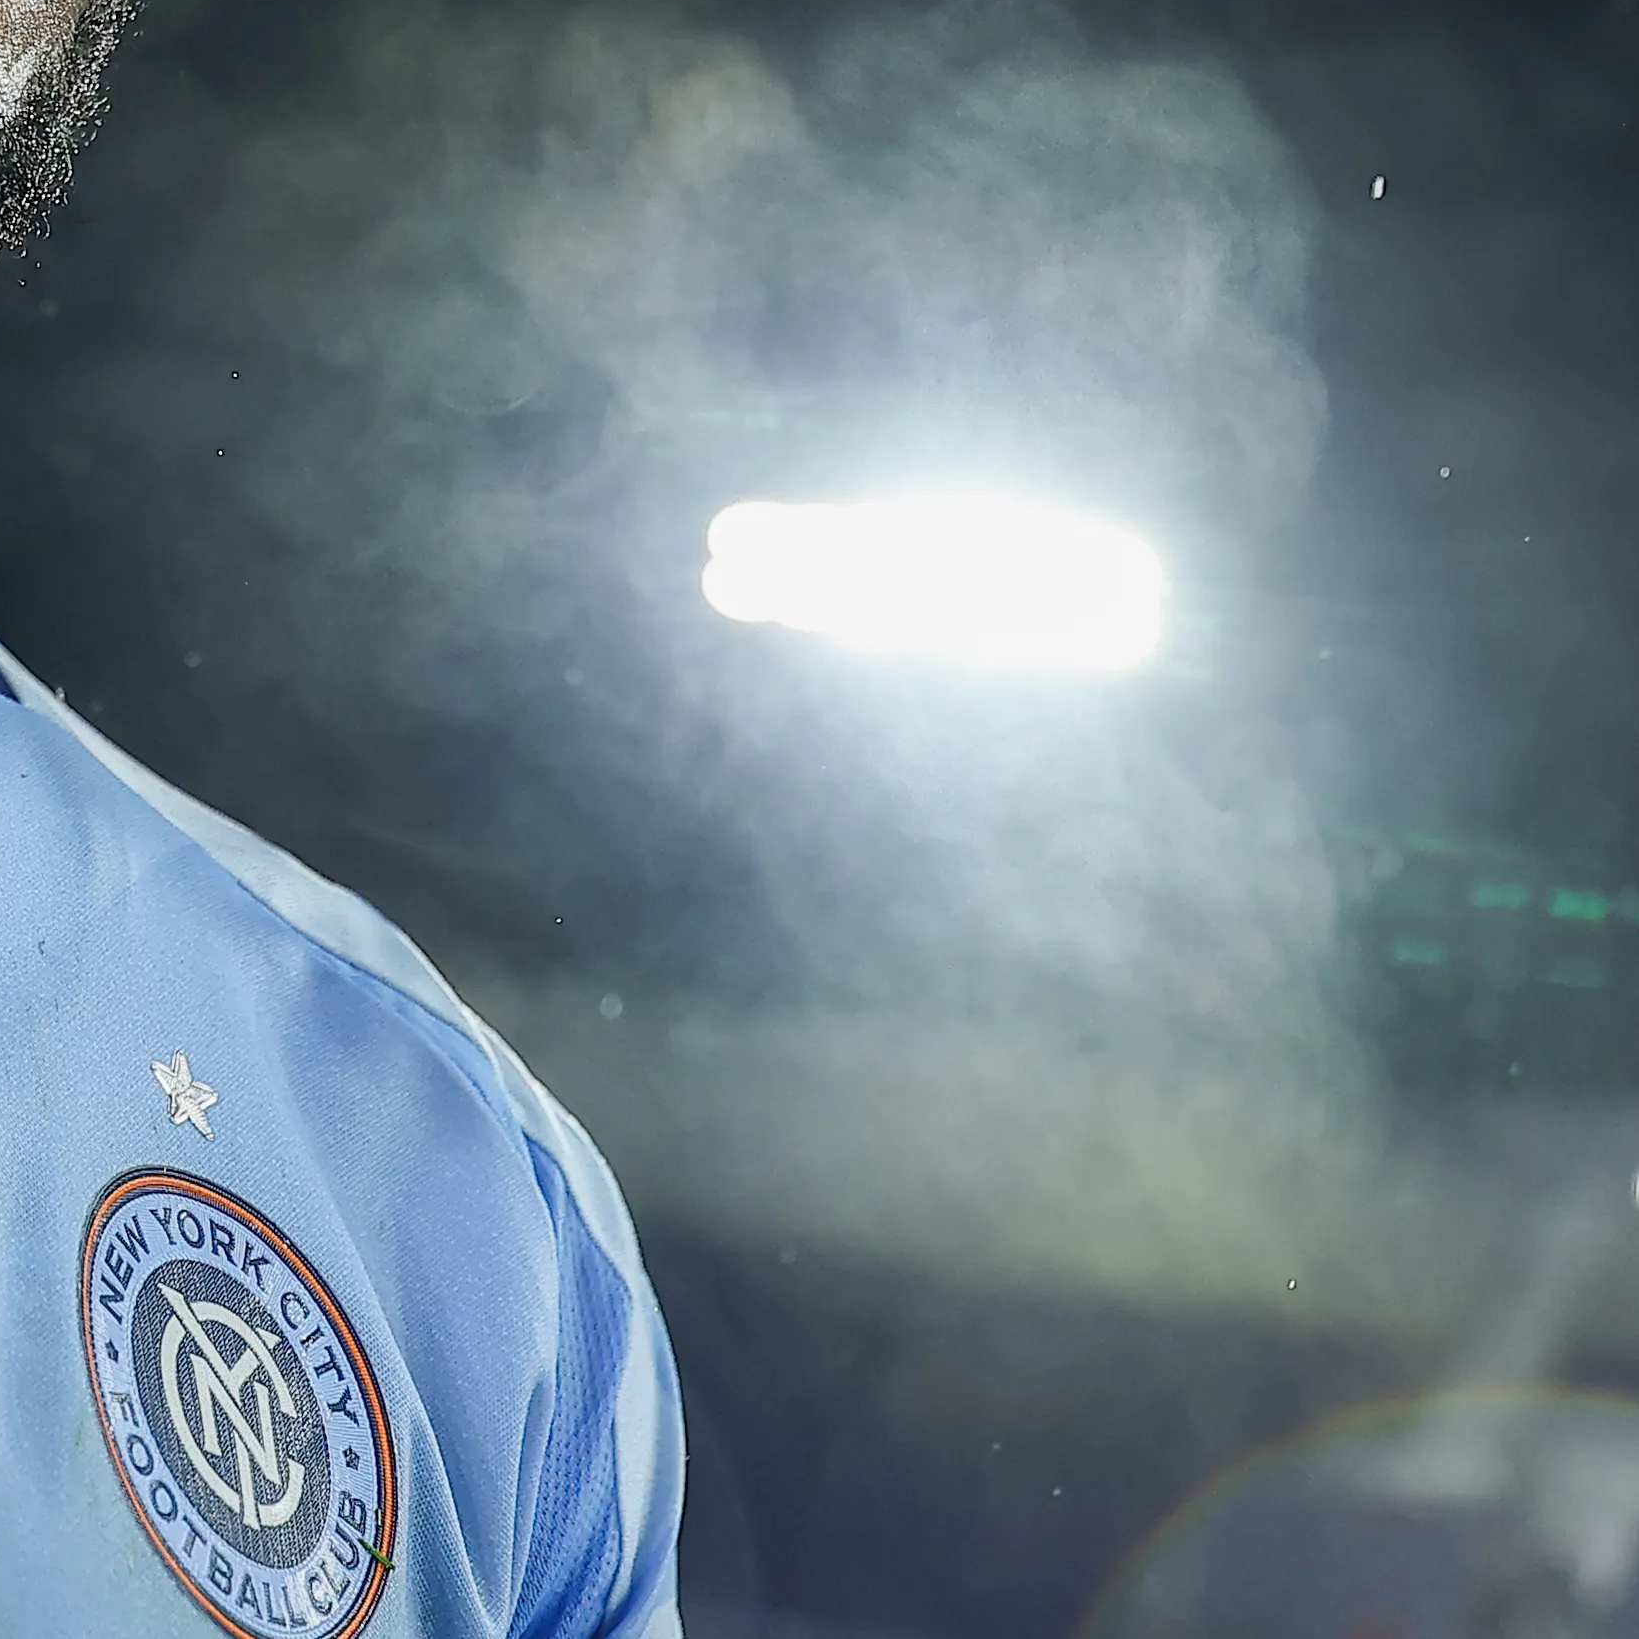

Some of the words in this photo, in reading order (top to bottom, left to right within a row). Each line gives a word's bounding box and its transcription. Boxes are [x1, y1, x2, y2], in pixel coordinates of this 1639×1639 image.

[99, 1215, 150, 1325] NEW
[149, 1207, 271, 1294] YORK
[281, 1292, 359, 1427] CITY
[109, 1391, 307, 1628] FOOTBALL
[306, 1491, 366, 1614] CLUB
